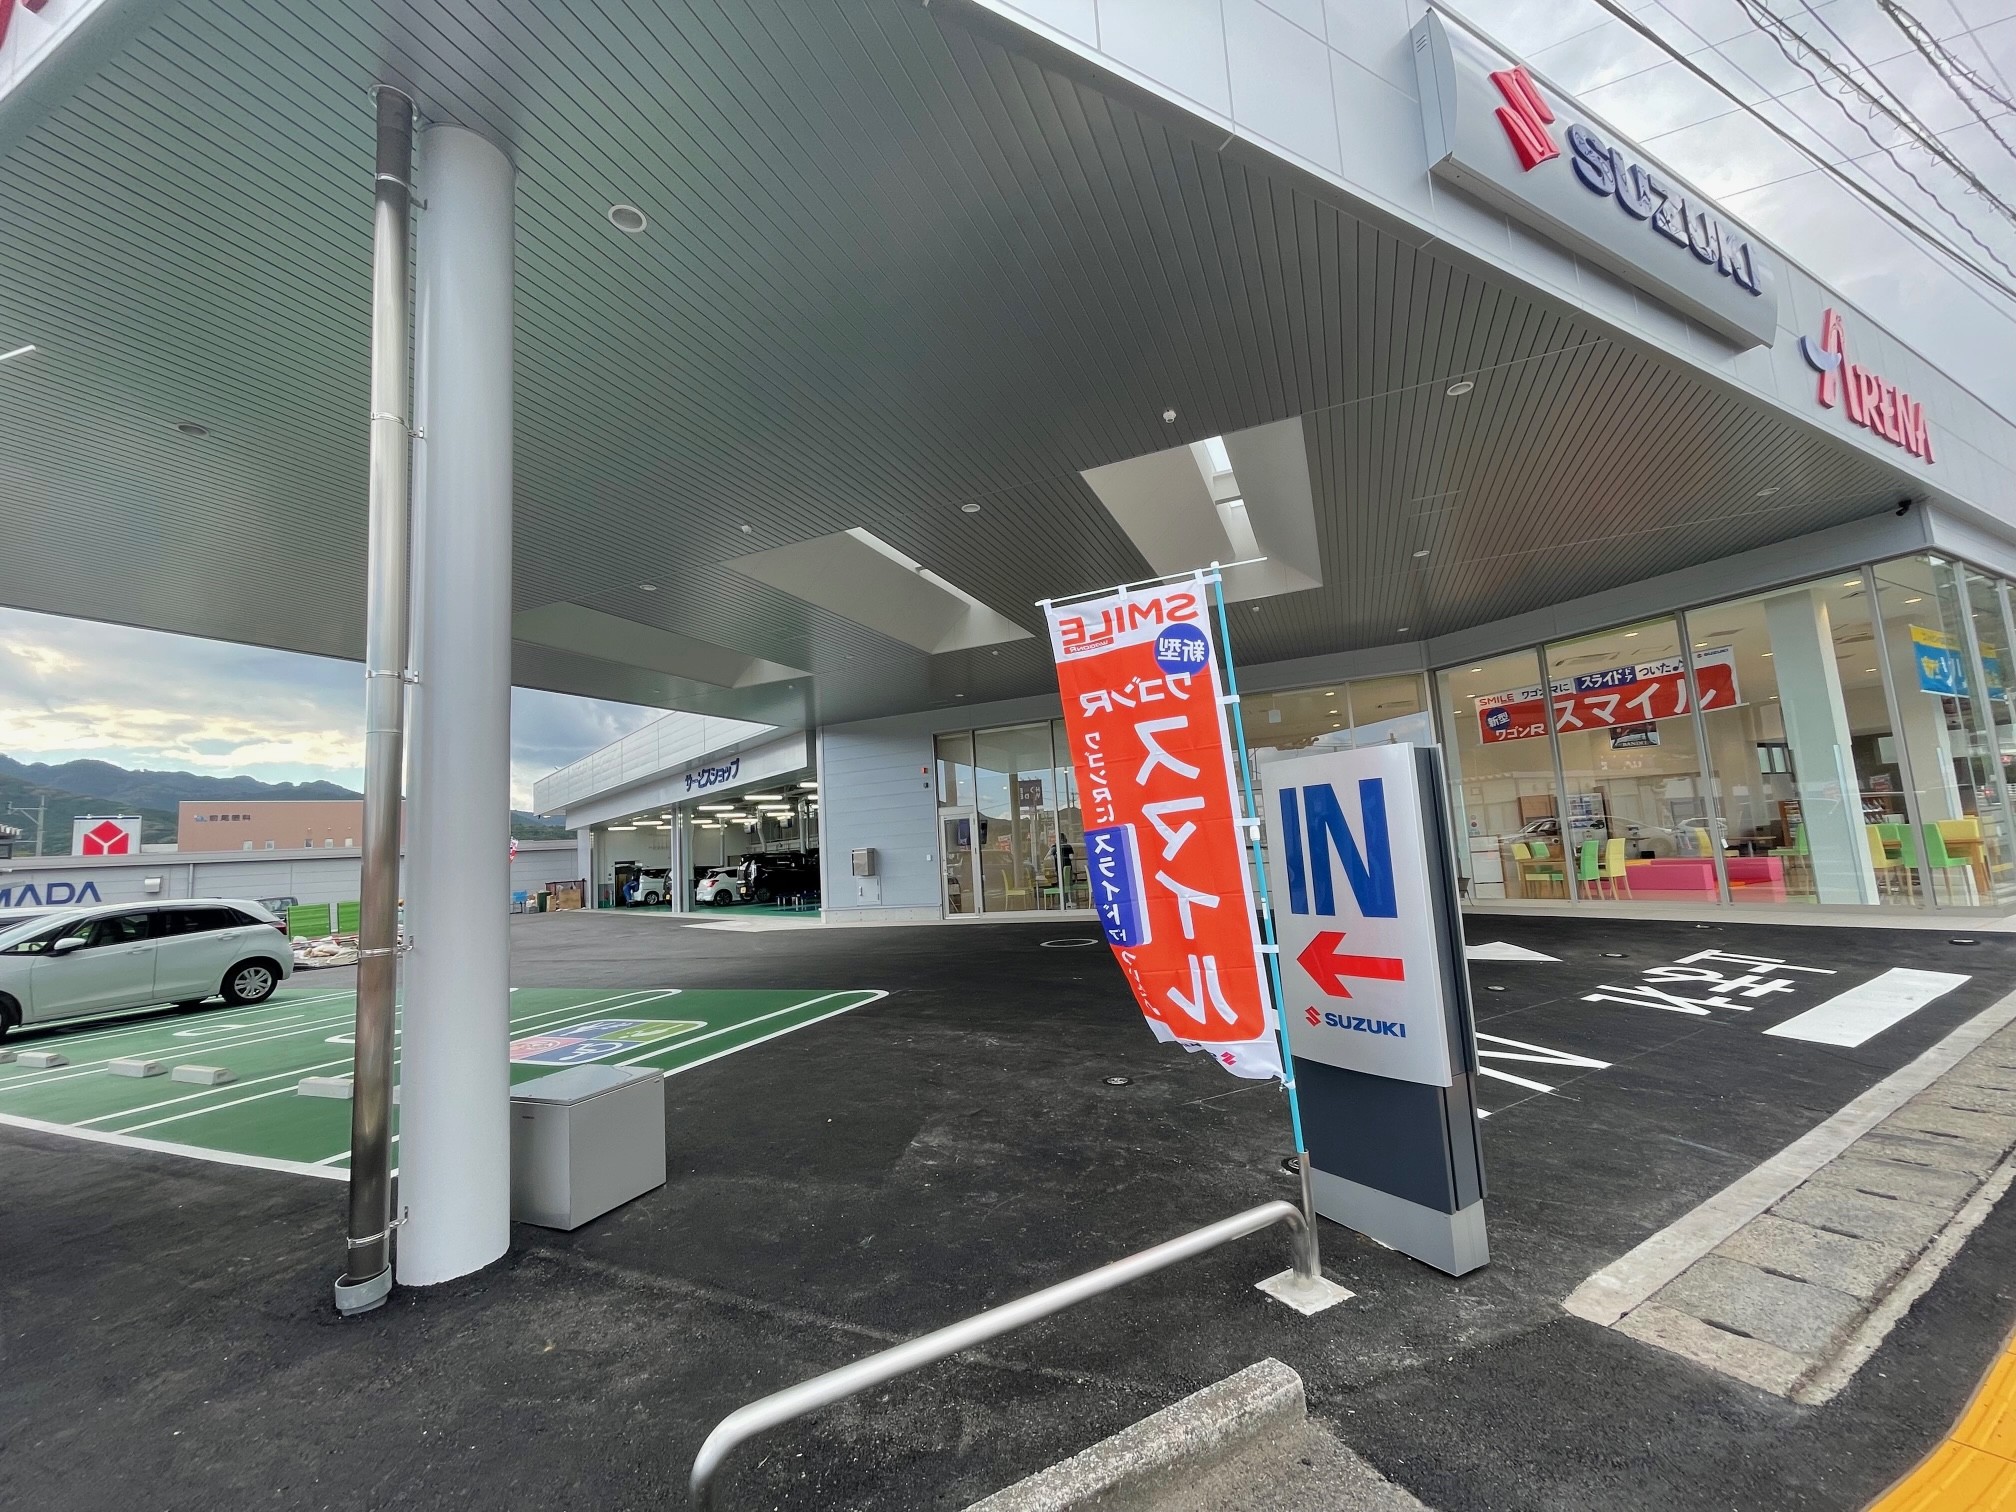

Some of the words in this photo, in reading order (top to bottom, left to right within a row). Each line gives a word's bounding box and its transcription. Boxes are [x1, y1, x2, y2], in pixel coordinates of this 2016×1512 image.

[1565, 123, 1762, 297] SUZUKI
[1800, 308, 1936, 465] ARENA
[1479, 693, 1515, 707] SMILE
[1554, 679, 1717, 730] スマイル
[1487, 711, 1510, 728] 新型
[1495, 723, 1546, 741] ワゴンR
[684, 757, 740, 792] サービスショップ
[1278, 777, 1399, 919] IN
[1324, 1012, 1407, 1039] SUZUKI
